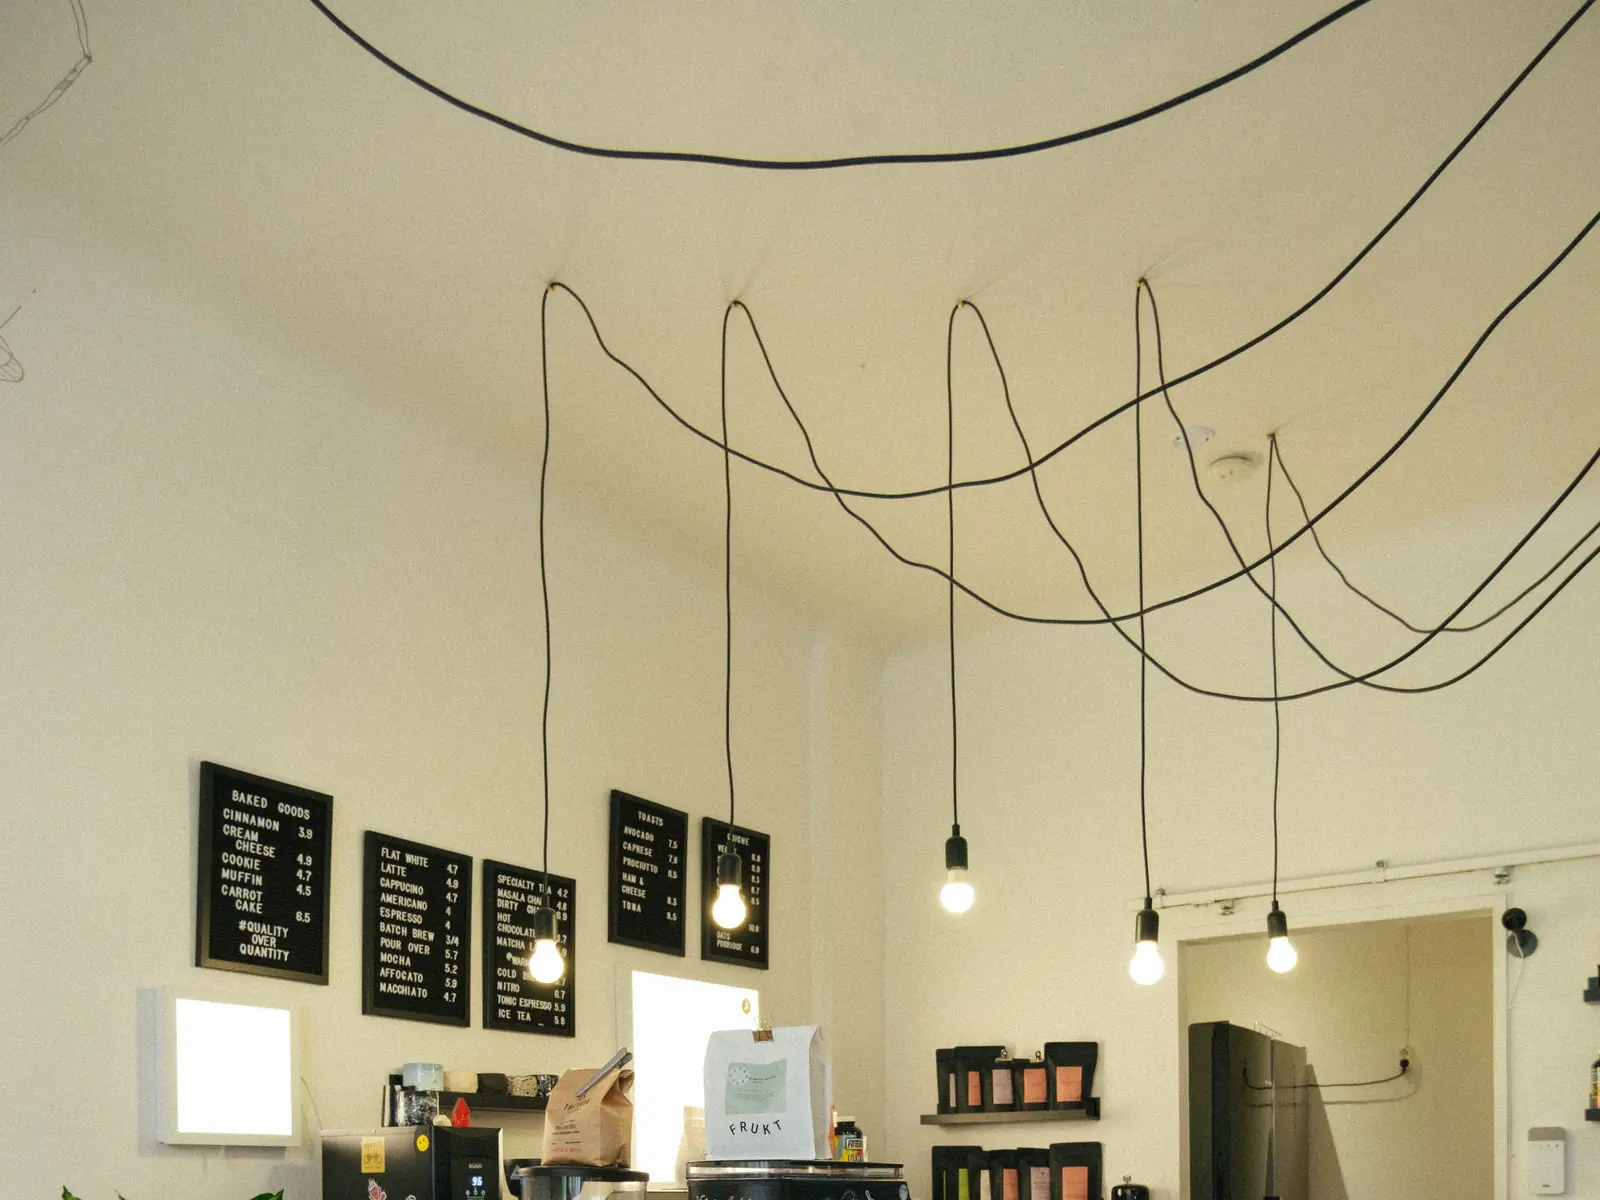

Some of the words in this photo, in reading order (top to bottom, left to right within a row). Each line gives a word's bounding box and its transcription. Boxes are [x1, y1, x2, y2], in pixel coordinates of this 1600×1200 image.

[232, 790, 267, 808] BAKED
[278, 802, 310, 820] GOODS
[223, 808, 280, 831] CINNAMON
[298, 827, 313, 840] 3.9
[638, 811, 664, 826] TOASTS
[223, 824, 259, 842] CREAM
[623, 825, 654, 842] AVOCADO
[236, 840, 276, 858] CHEESE
[297, 853, 312, 866] 4.9
[622, 841, 653, 857] CAPRESE
[222, 852, 260, 870] COOKIE
[296, 869, 312, 881] 4.7
[381, 847, 401, 860] FLAT
[405, 853, 429, 868] WHITE
[446, 864, 459, 875] 4.7
[381, 862, 407, 877] LATTE
[221, 867, 263, 886] MUFFIN
[296, 884, 312, 896] 4.5
[497, 874, 535, 891] SPECIALTY
[557, 888, 568, 898] 4.2
[622, 872, 637, 884] HAM
[221, 884, 263, 901] CARROT
[380, 877, 424, 896] CAPPUCINO
[445, 892, 458, 903] 4.7
[497, 888, 526, 902] MASALA
[621, 884, 646, 898] CHEESE
[235, 899, 263, 914] CAKE
[380, 892, 428, 911] AMERICANO
[445, 906, 451, 916] 4
[497, 898, 519, 911] DIRTY
[622, 900, 641, 912] TUNA
[380, 907, 423, 924] ESPRESSO
[445, 920, 451, 930] 4
[497, 912, 511, 923] HOT
[239, 920, 289, 938] #QUALITY
[380, 922, 407, 937] BATCH
[412, 928, 435, 942] BREW
[251, 934, 277, 948] OVER
[380, 937, 402, 950] POUR
[408, 942, 430, 955] OVER
[445, 949, 459, 960] 5.7
[497, 936, 526, 950] MATCHA
[240, 943, 289, 962] QUANTITY
[380, 952, 411, 967] MOCHA
[444, 963, 458, 974] 5.2
[380, 967, 424, 983] AFFOGATO
[497, 967, 517, 979] COLD
[379, 982, 428, 998] MACCHIATO
[443, 992, 457, 1003] 4.7
[497, 981, 520, 993] NITRO
[497, 994, 517, 1006] TONIC
[519, 998, 552, 1011] ESPRESSO
[498, 1009, 512, 1019] ICE
[516, 1011, 531, 1021] TEA
[729, 1119, 782, 1136] FRUKT
[472, 1176, 483, 1187] 96
